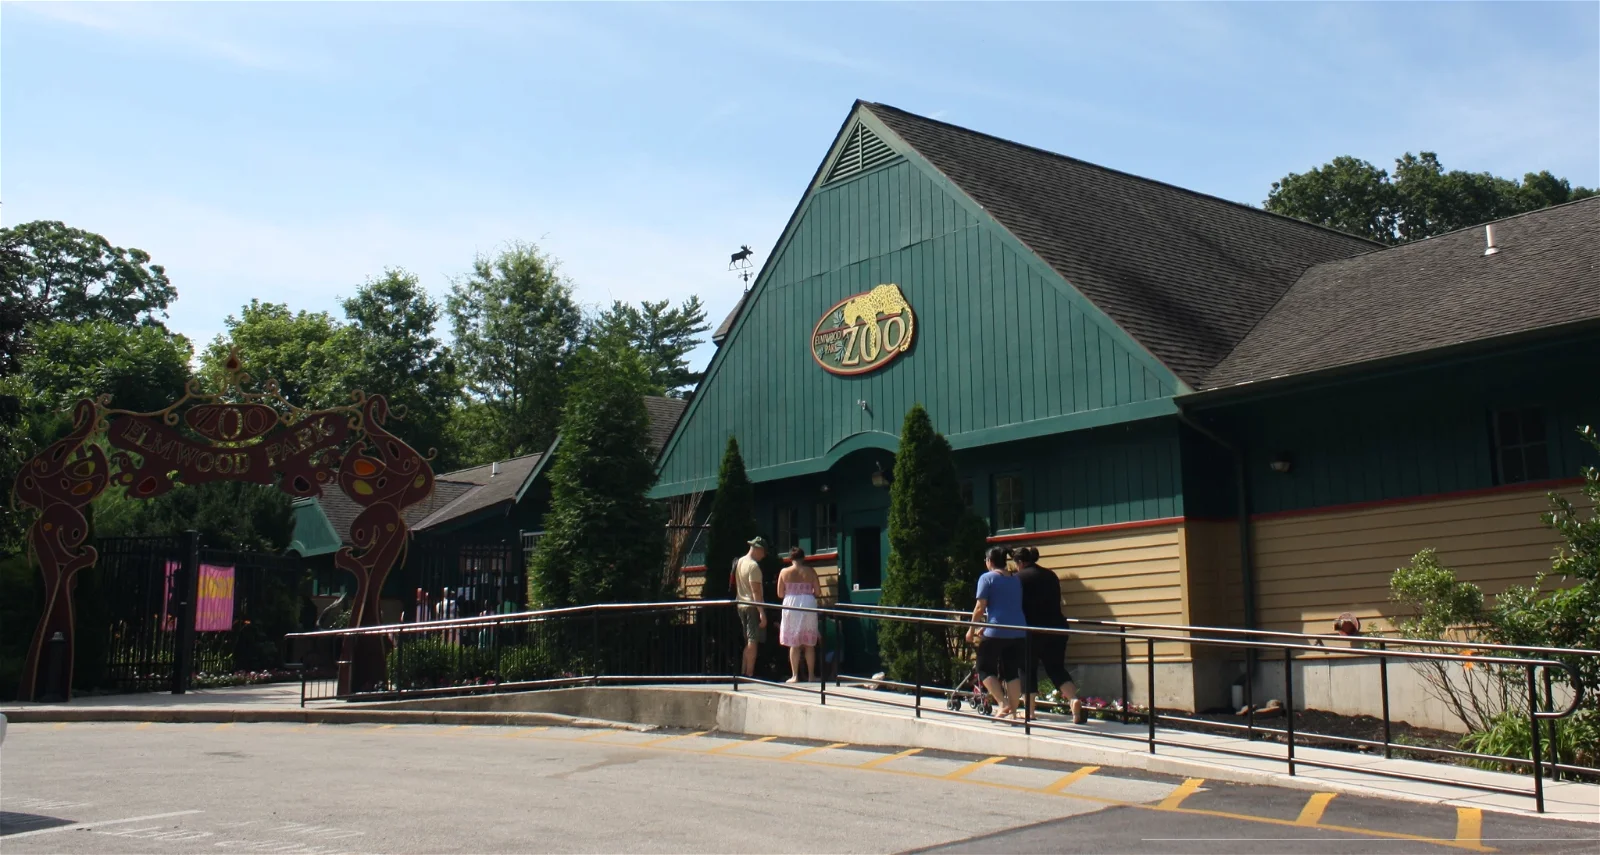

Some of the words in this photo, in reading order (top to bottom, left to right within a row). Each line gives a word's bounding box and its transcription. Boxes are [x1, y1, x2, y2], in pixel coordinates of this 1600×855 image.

[842, 317, 906, 365] ZOO
[121, 418, 249, 473] ELMWOOD
[265, 416, 335, 467] PARK
[195, 407, 267, 439] ZOO
